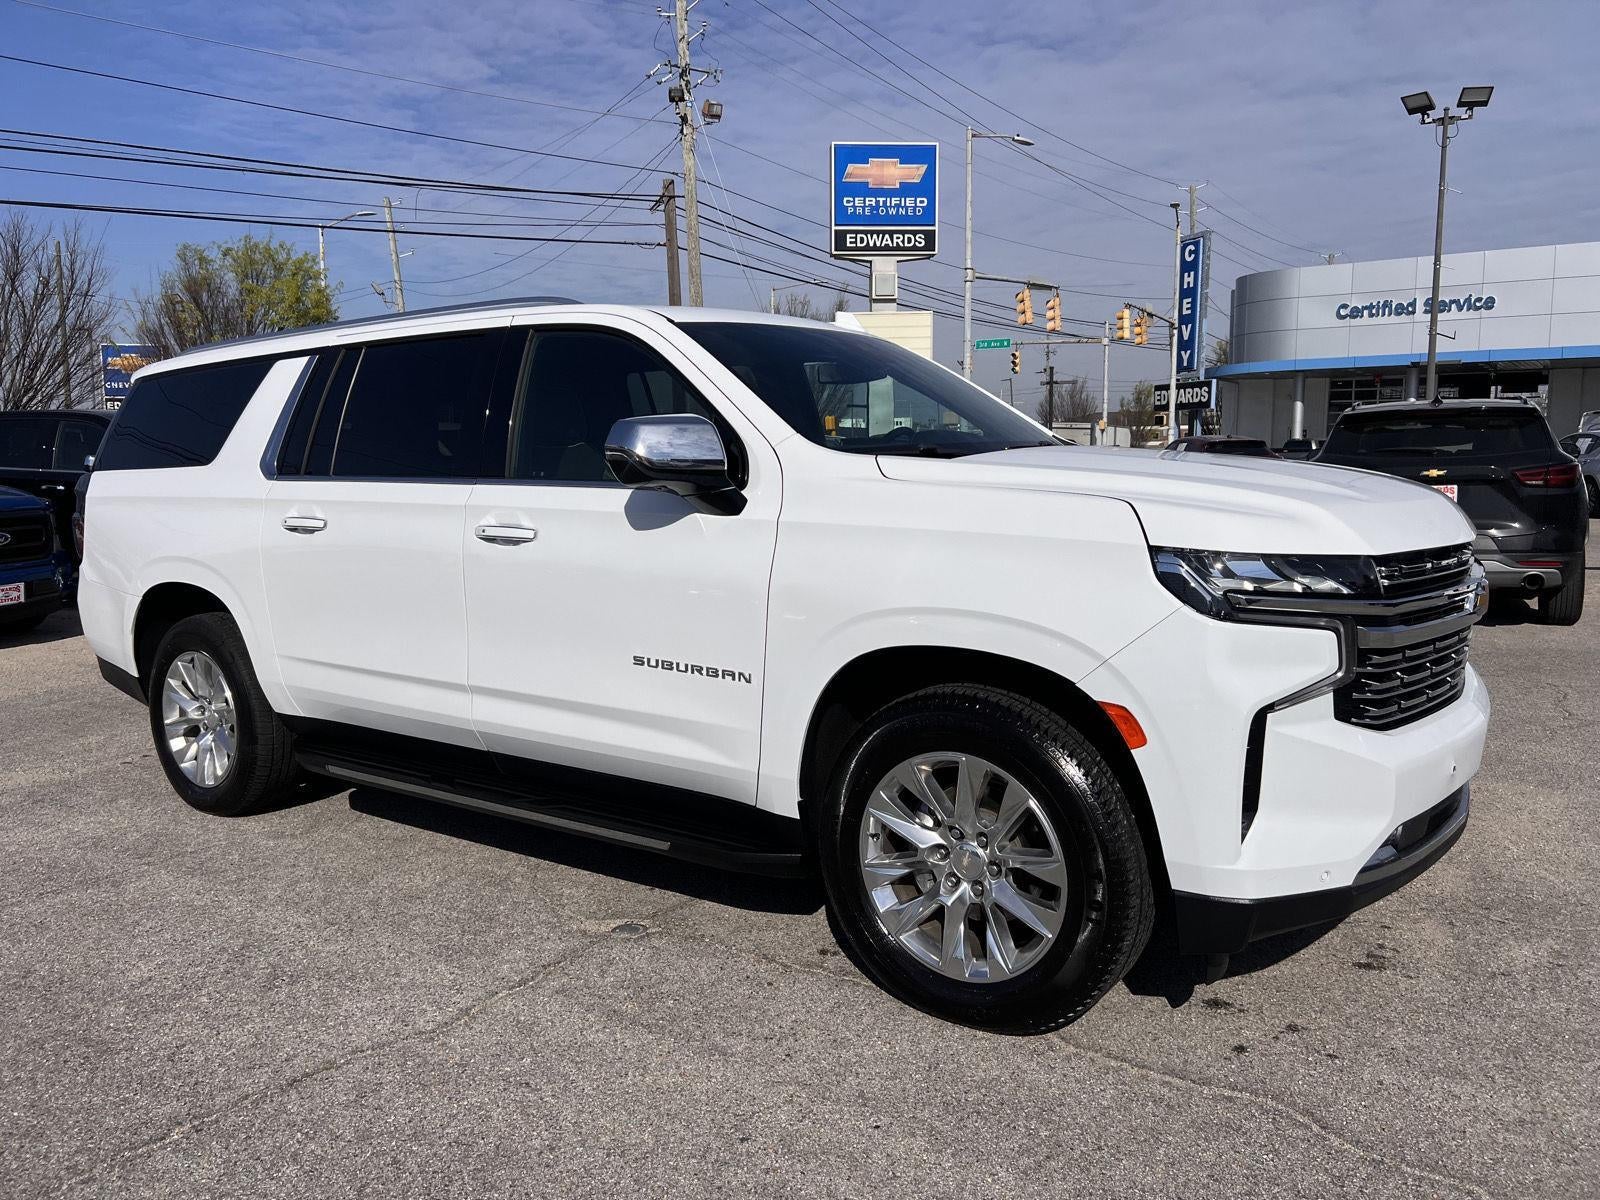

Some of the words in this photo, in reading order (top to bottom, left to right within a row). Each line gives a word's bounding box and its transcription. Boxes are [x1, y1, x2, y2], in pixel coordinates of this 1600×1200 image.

[843, 197, 928, 207] CERTIFIED
[847, 207, 923, 216] PRE-OWNED
[846, 233, 926, 248] EDWARDS
[1180, 244, 1196, 367] CHEVY
[1336, 298, 1417, 321] Certified
[1422, 293, 1496, 315] Service
[632, 655, 752, 684] SUBURBAN
